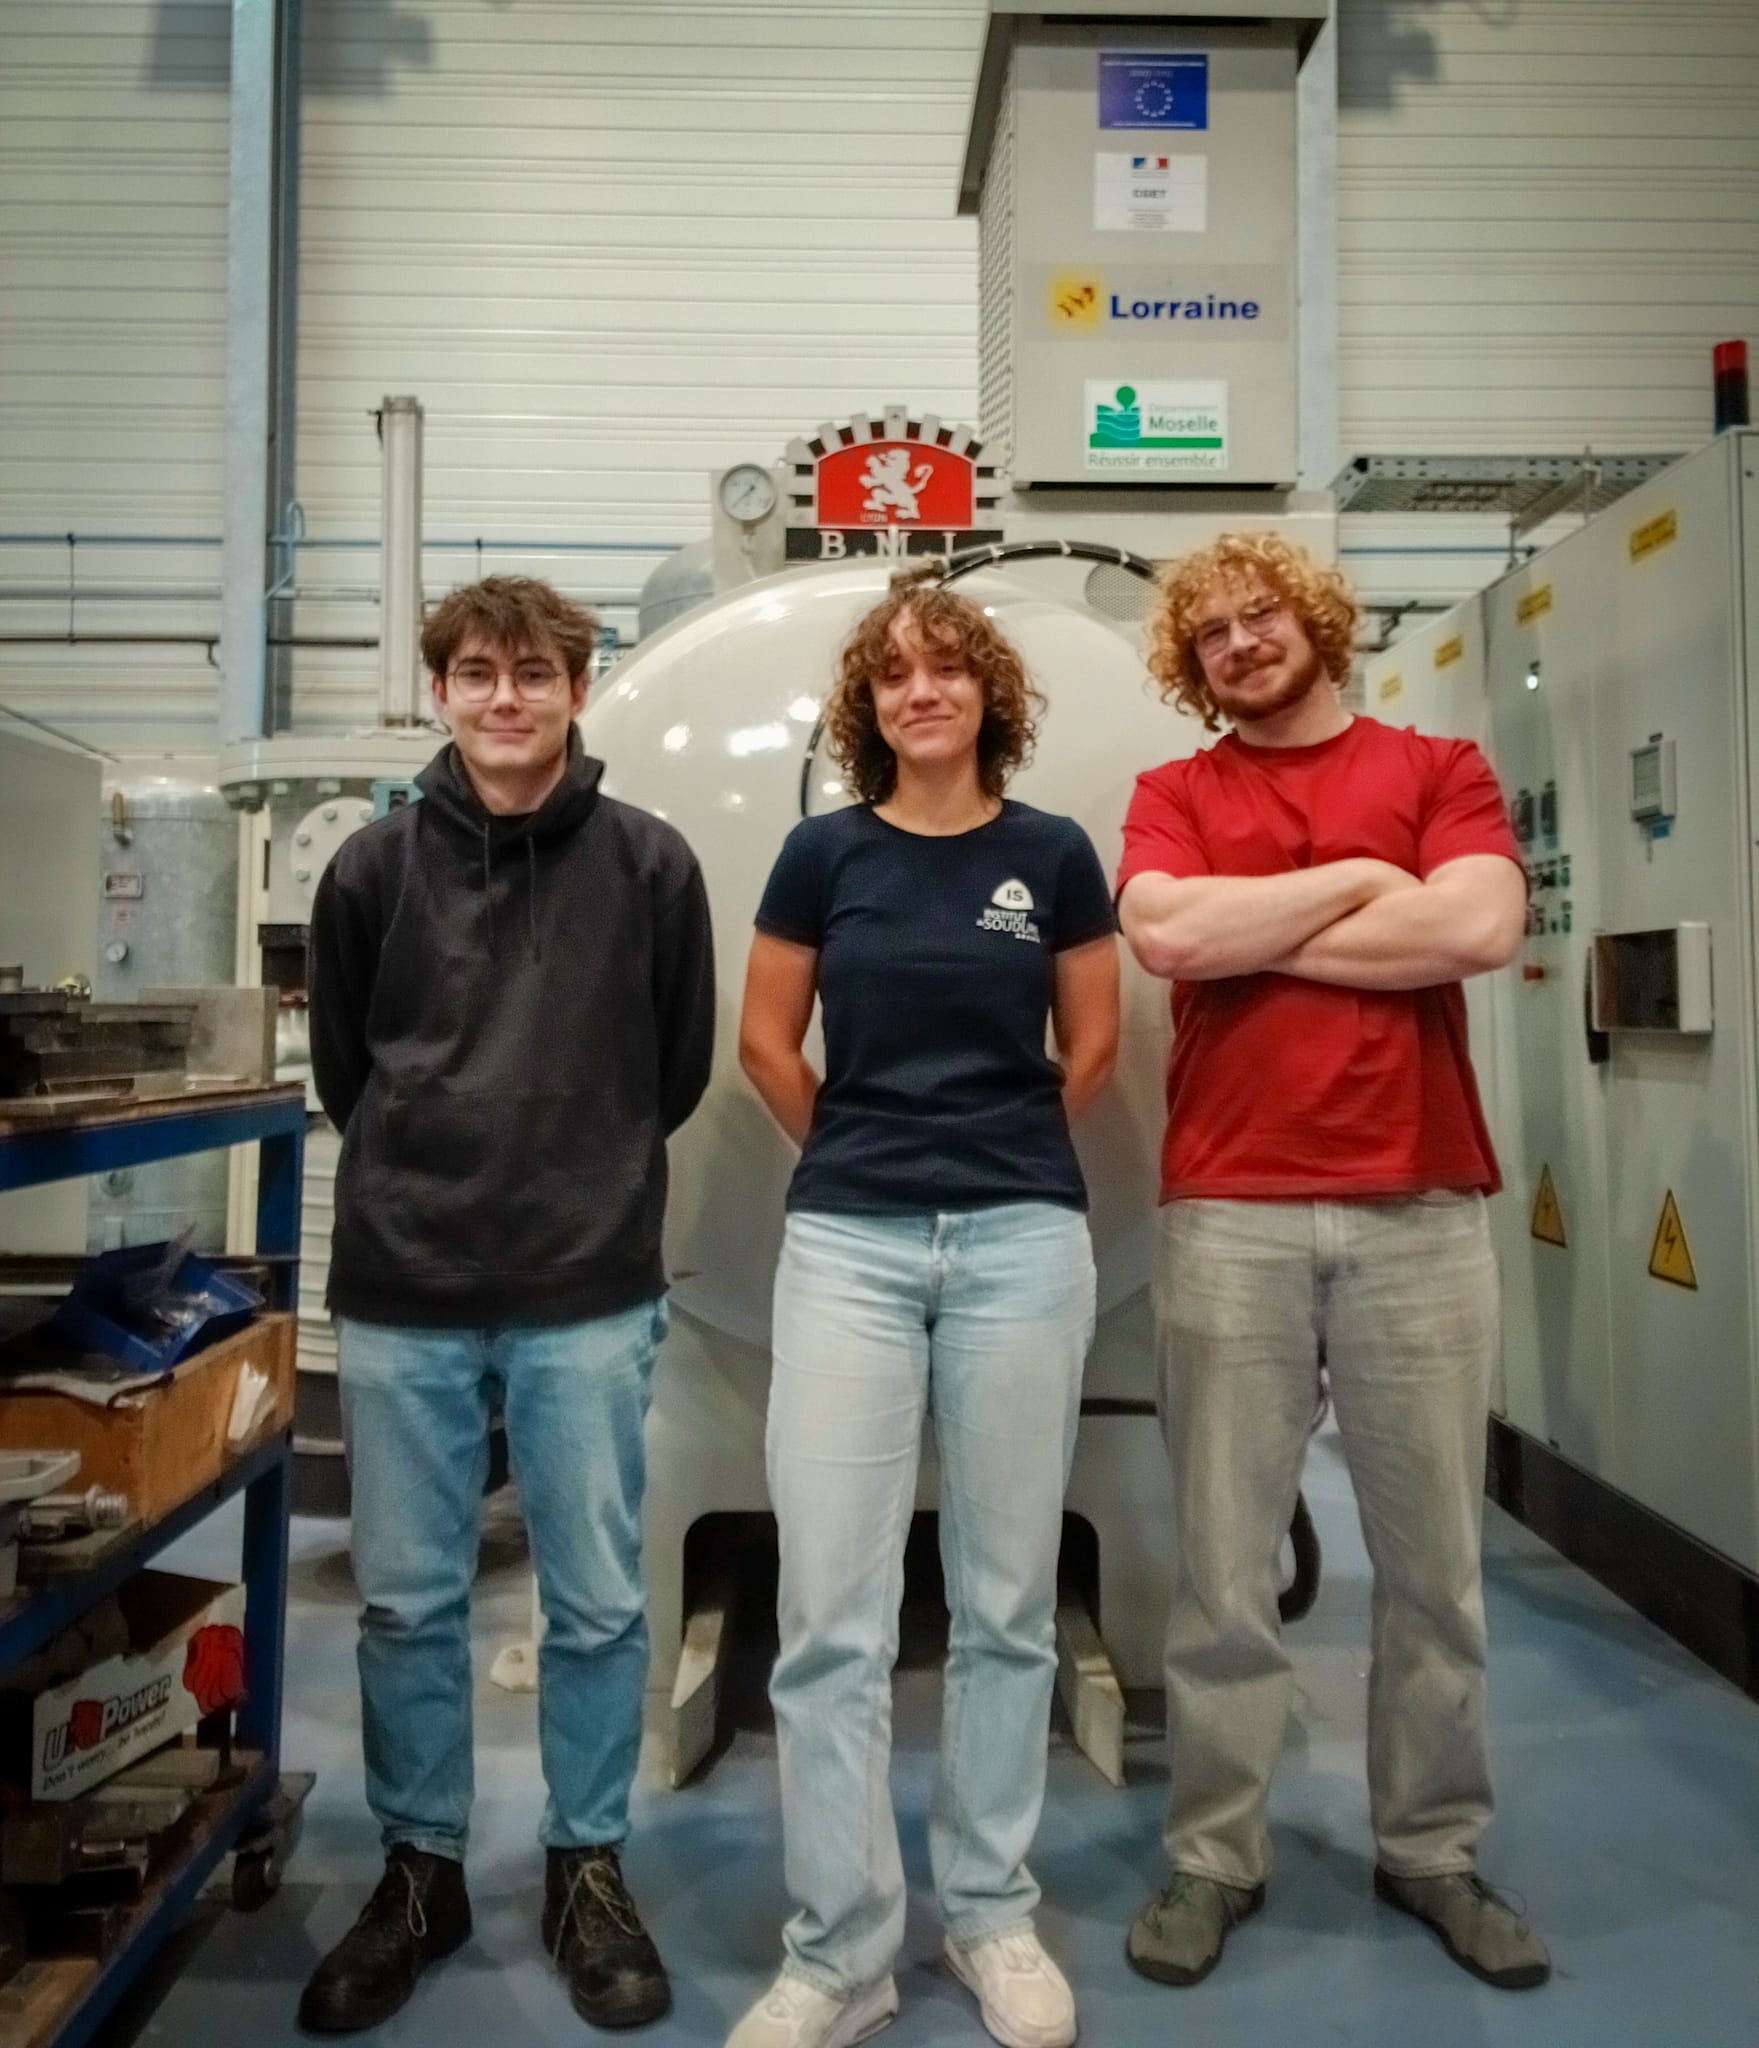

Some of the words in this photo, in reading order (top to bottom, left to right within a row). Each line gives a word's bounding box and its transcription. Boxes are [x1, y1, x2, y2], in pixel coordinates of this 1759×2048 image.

[1110, 294, 1260, 319] Lorraine
[1149, 416, 1218, 432] Moselle
[1145, 452, 1216, 468] ensemble
[1006, 889, 1024, 902] IS
